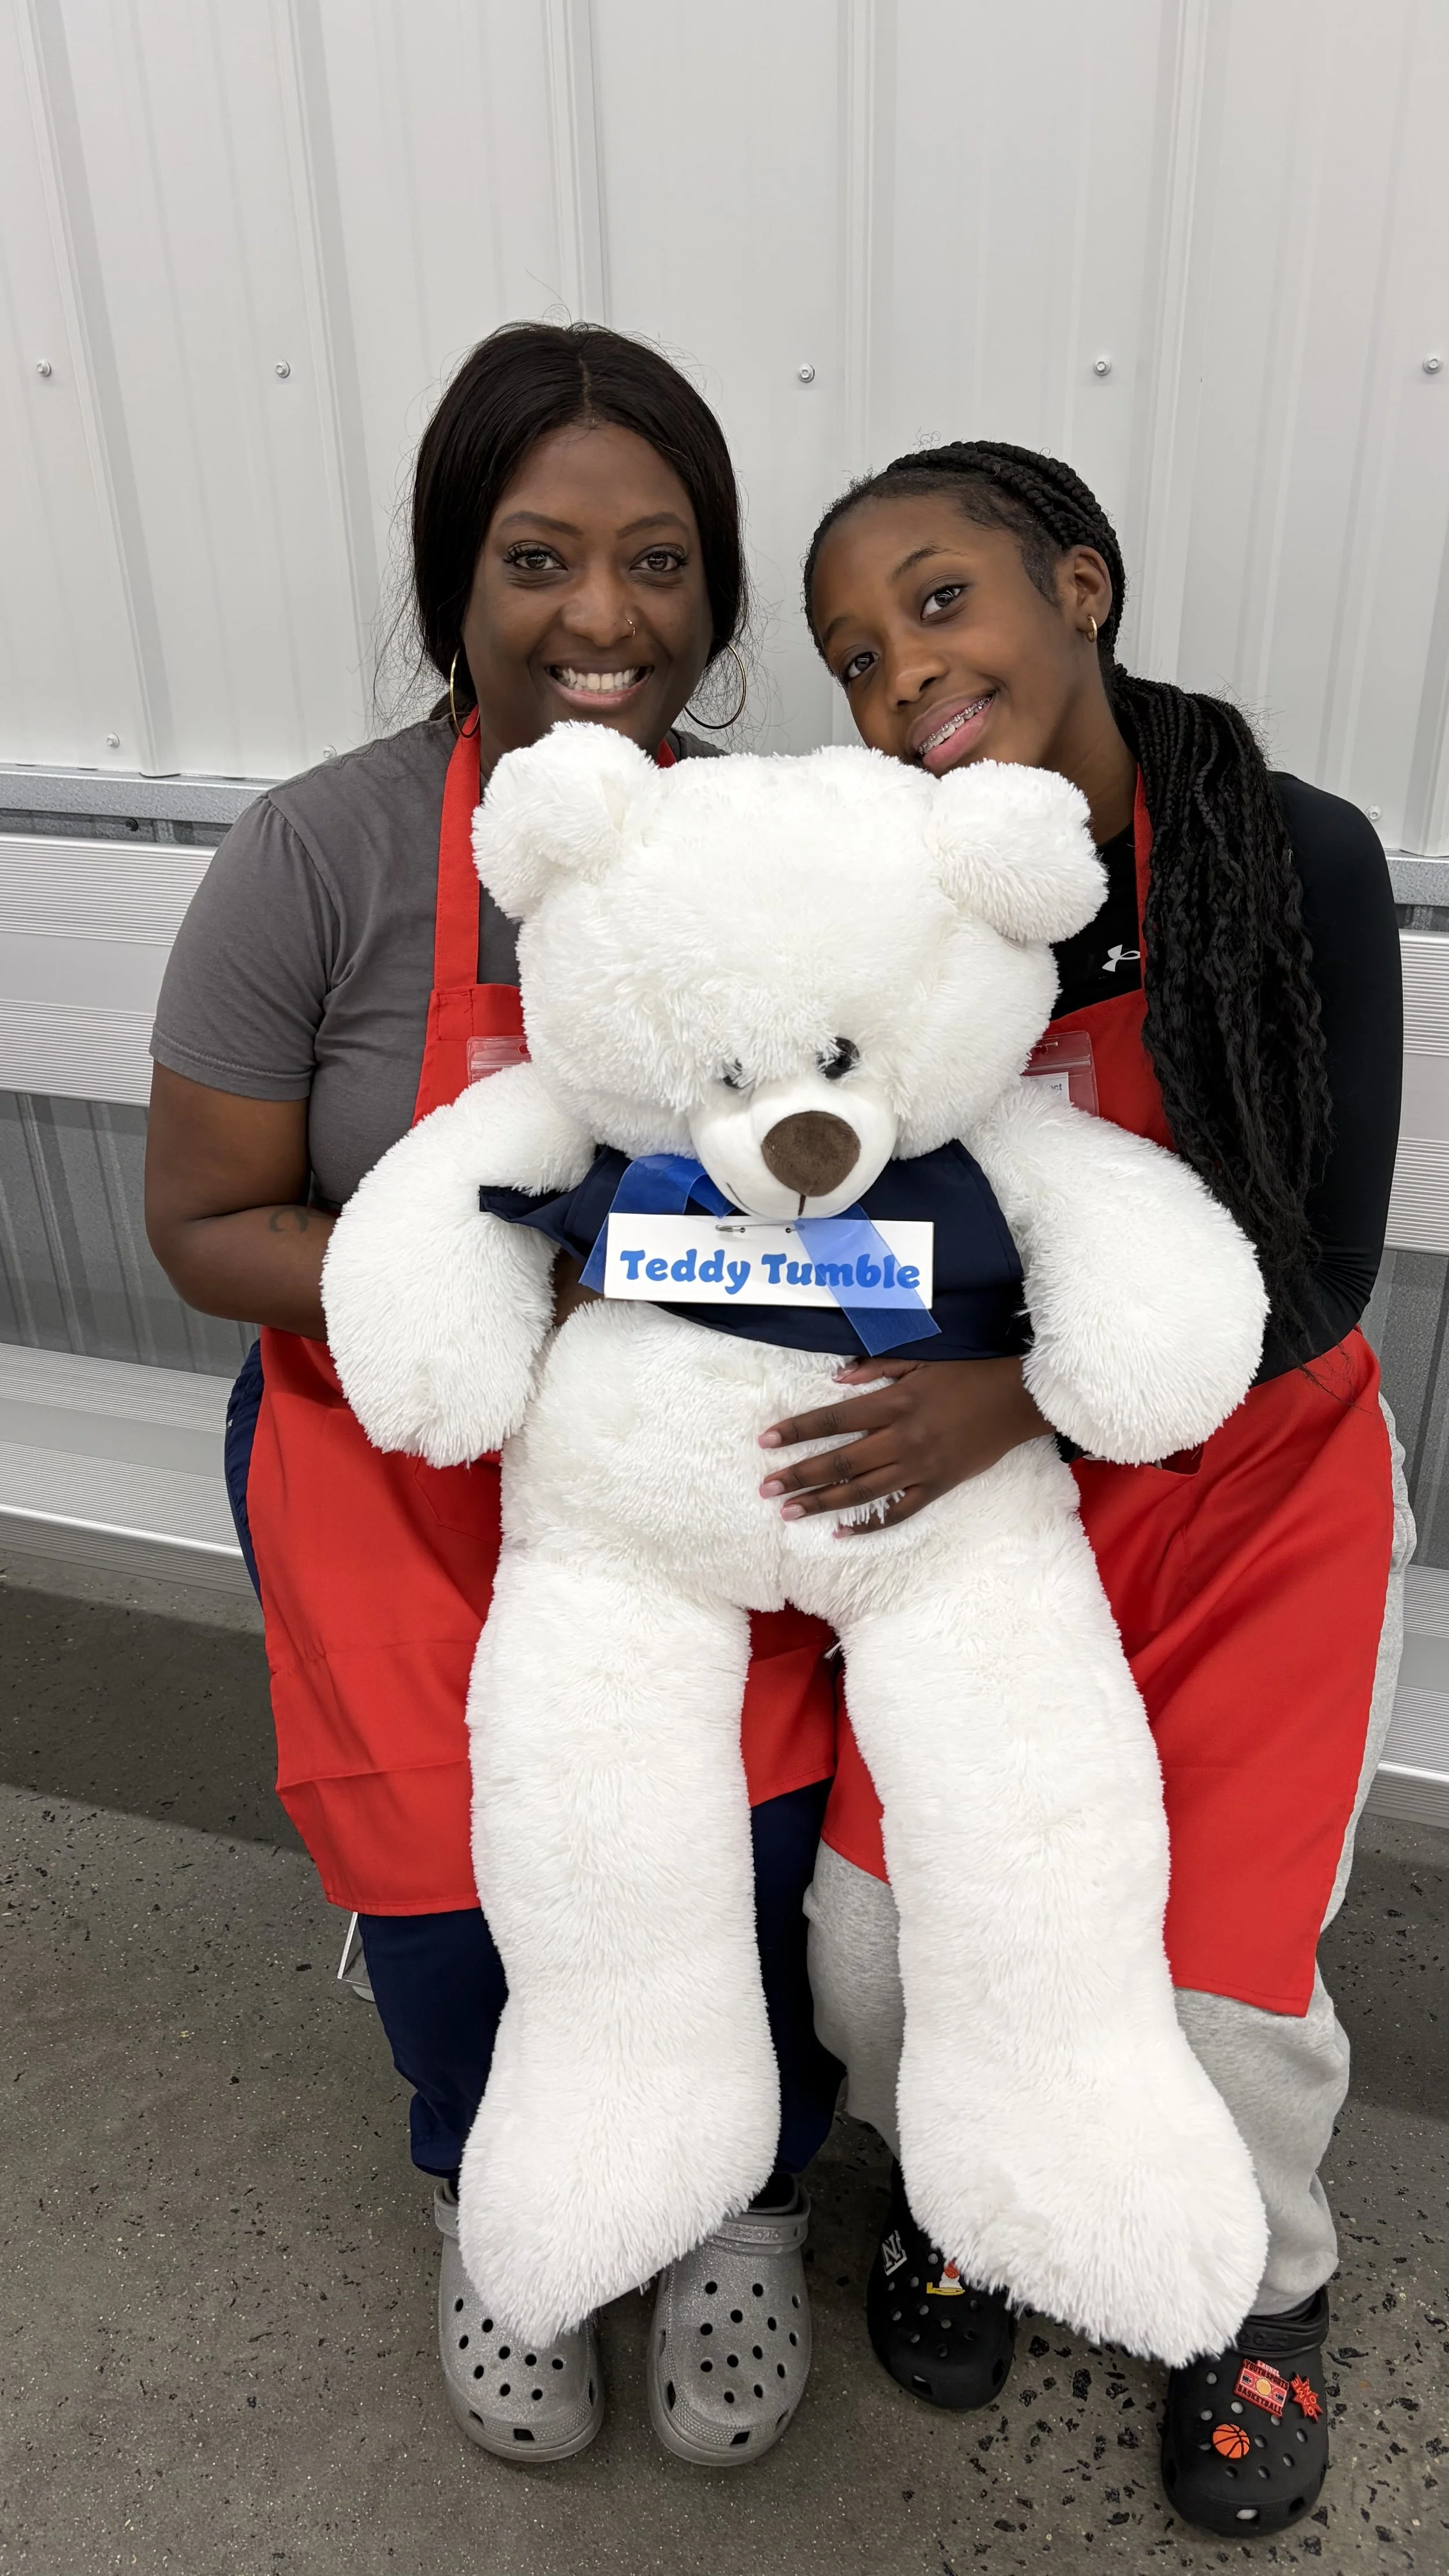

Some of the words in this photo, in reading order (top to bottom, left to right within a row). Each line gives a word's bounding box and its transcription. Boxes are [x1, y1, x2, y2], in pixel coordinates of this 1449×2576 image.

[620, 1249, 751, 1295] Teddy
[761, 1253, 920, 1289] Tumble
[1245, 2360, 1266, 2377] YOUTH
[1266, 2373, 1289, 2391] SPORTS
[1237, 2384, 1281, 2414] BASKETBALL
[1291, 2378, 1314, 2416] GAME
